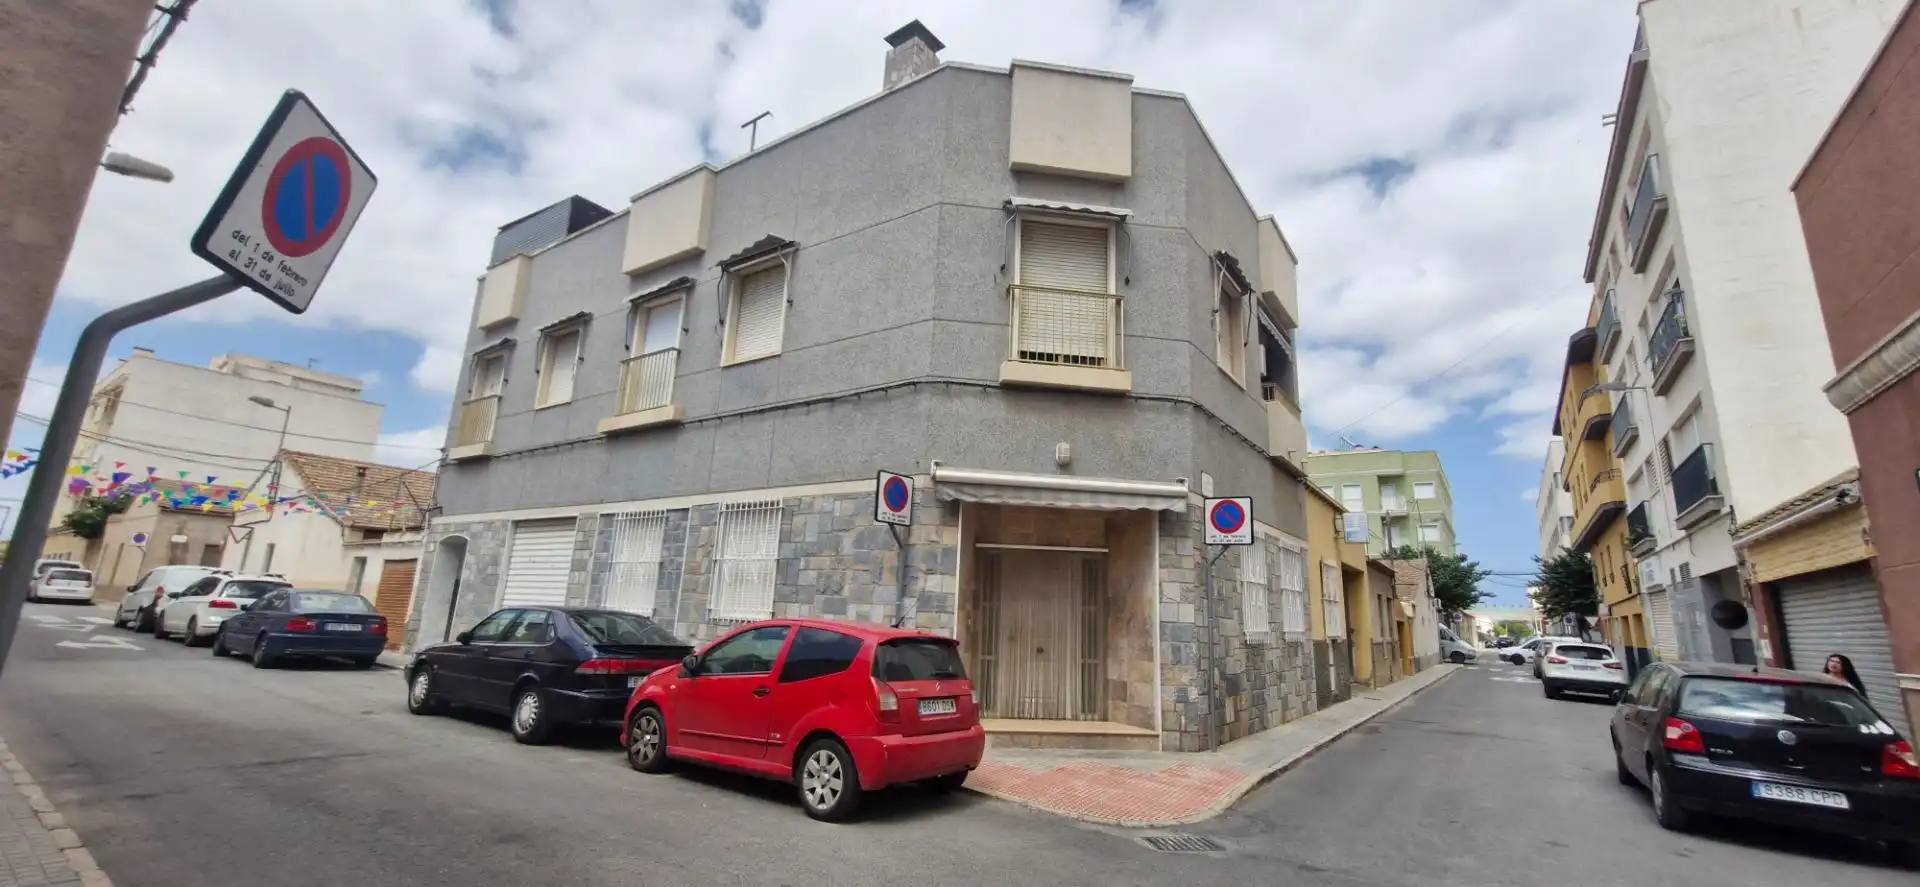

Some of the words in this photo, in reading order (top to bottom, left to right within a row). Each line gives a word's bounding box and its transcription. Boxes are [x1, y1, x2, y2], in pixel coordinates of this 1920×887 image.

[228, 249, 242, 262] al
[243, 256, 258, 272] 31
[259, 268, 272, 281] de
[273, 278, 296, 297] julio
[232, 229, 252, 247] del
[253, 242, 261, 253] 1
[261, 251, 274, 263] de
[277, 259, 308, 287] febrero
